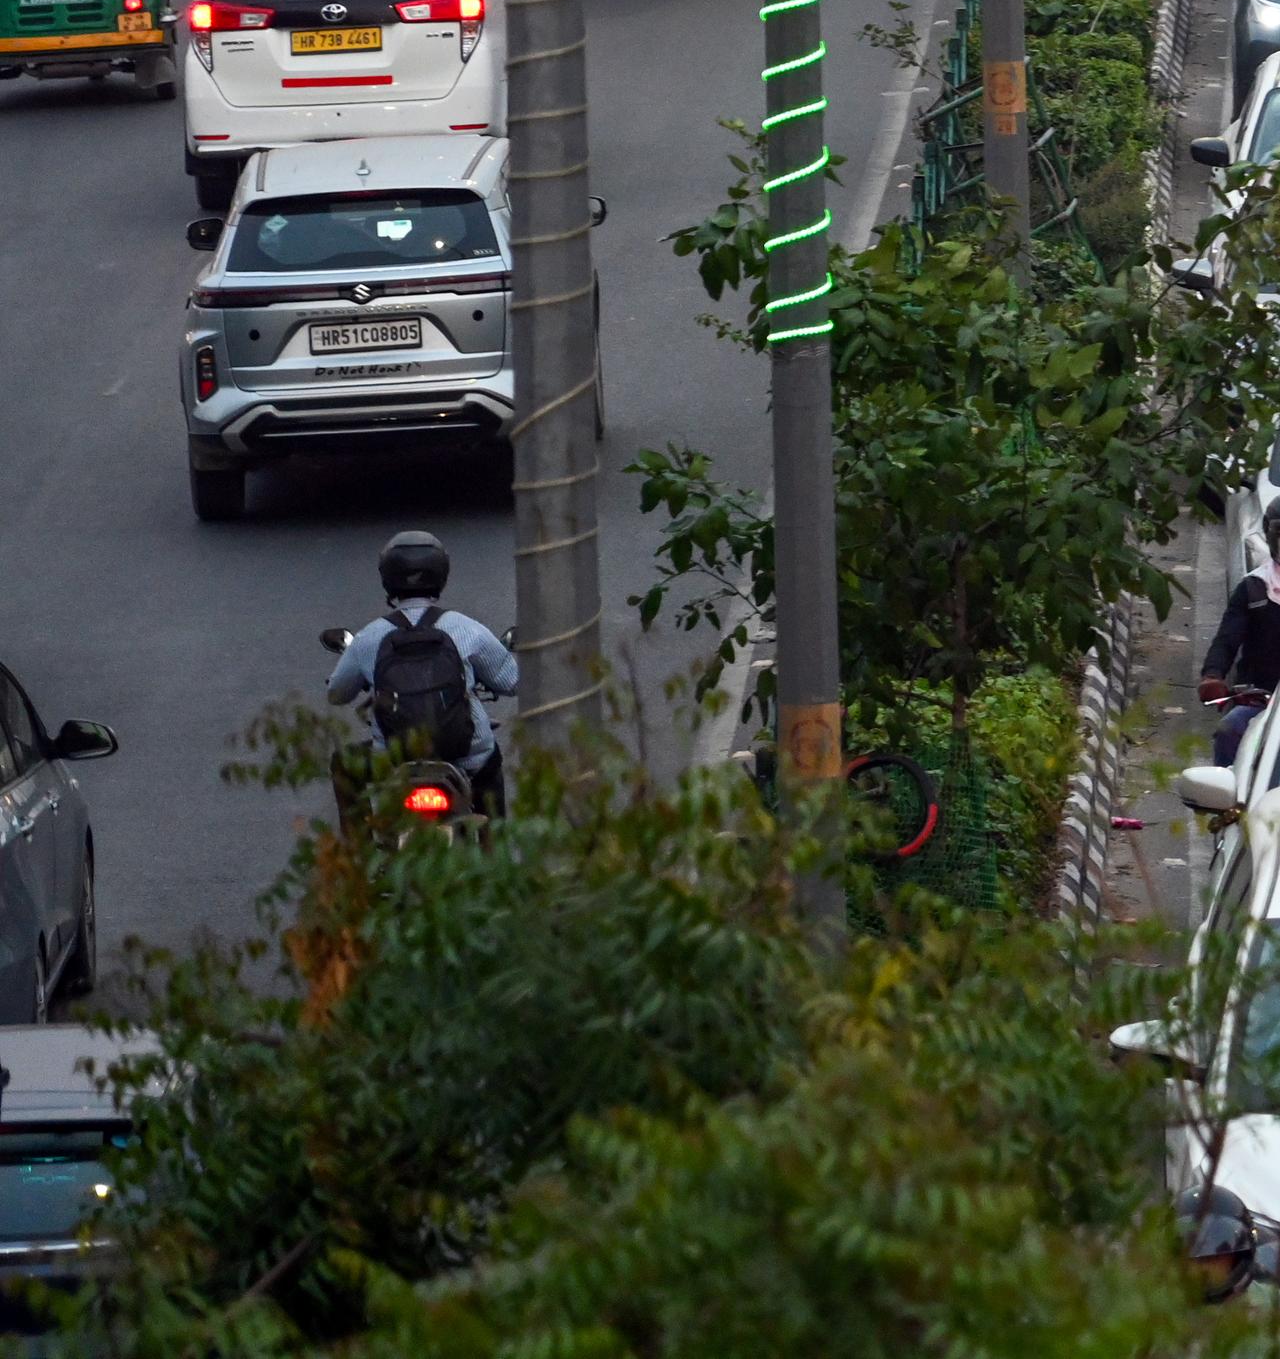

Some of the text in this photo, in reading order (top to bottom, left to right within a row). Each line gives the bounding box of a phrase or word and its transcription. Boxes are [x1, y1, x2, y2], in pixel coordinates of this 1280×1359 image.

[300, 35, 317, 49] HR
[347, 29, 379, 46] 4461
[321, 324, 419, 347] HR51CQ8805
[314, 365, 335, 377] Do
[340, 364, 364, 376] Not
